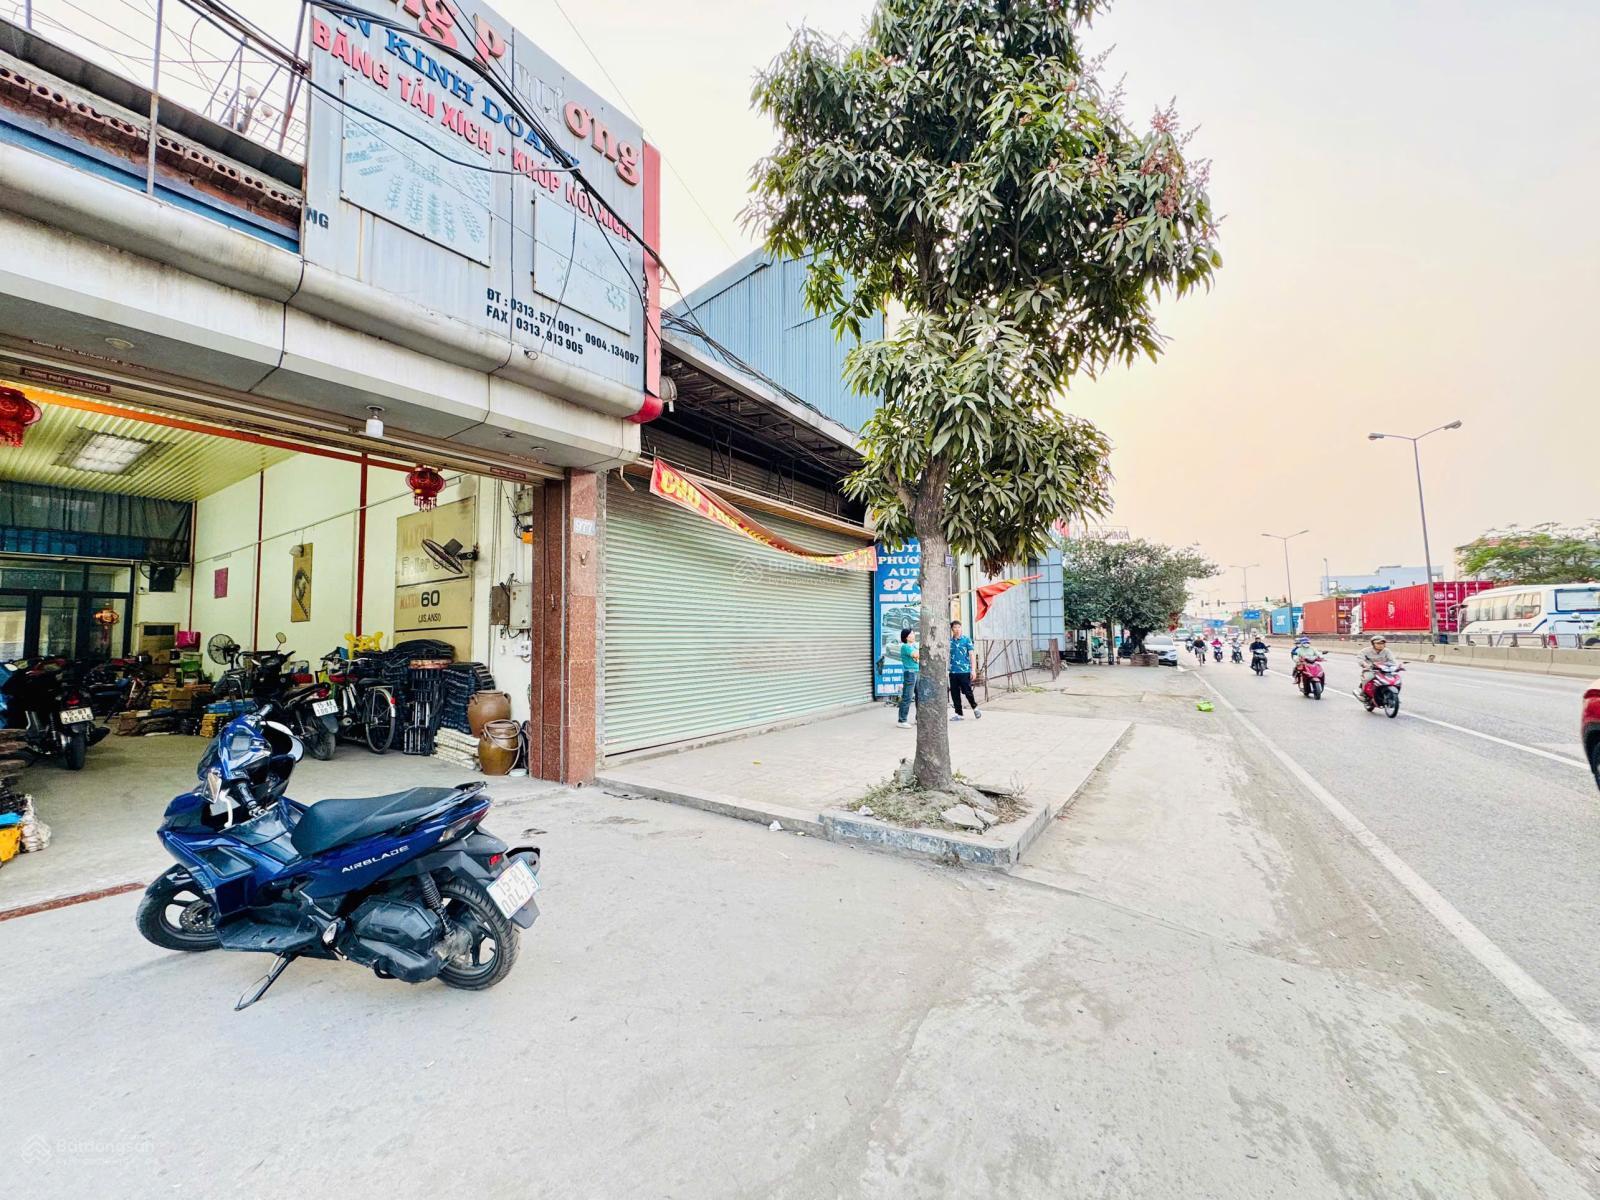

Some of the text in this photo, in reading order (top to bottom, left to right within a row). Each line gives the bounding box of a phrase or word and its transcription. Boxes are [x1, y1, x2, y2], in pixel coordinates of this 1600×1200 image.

[312, 16, 390, 91] BĂNG
[398, 72, 436, 119] TẢI
[385, 29, 475, 107] KINH
[486, 304, 508, 324] FAX
[421, 590, 440, 608] 60
[341, 845, 411, 874] AIRBLADE
